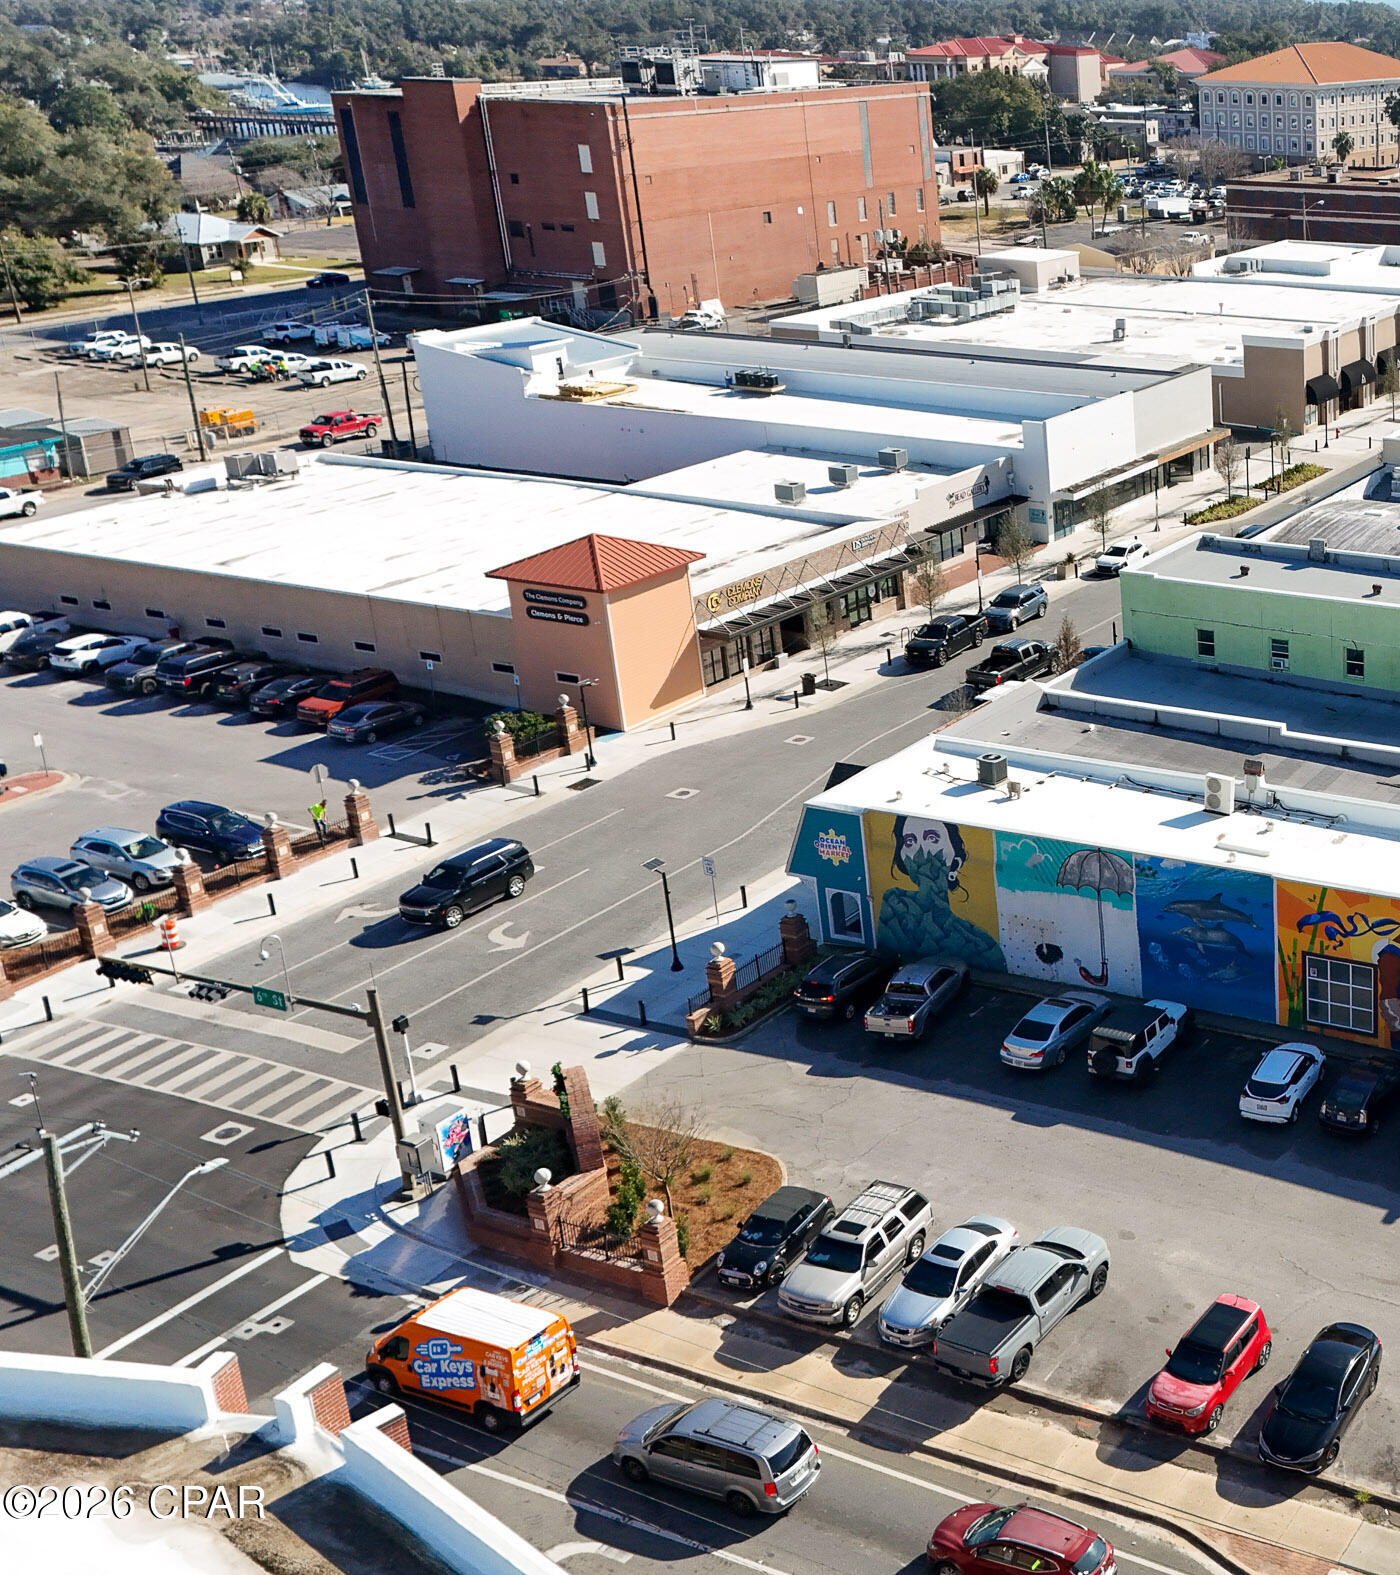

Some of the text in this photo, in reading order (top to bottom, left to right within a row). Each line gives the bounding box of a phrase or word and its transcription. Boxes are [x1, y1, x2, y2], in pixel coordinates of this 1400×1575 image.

[728, 577, 761, 596] CLEMONS
[525, 592, 583, 607] The Clemons Company
[729, 586, 762, 606] COMPANY
[531, 609, 556, 620] Clemons
[564, 614, 583, 623] Pierce
[814, 840, 851, 854] ORIENTAL
[819, 837, 846, 845] OCEAN
[819, 848, 849, 859] MARKET
[272, 994, 283, 1007] St
[413, 1360, 437, 1373] Car
[440, 1360, 473, 1375] Keys
[421, 1375, 475, 1390] Express
